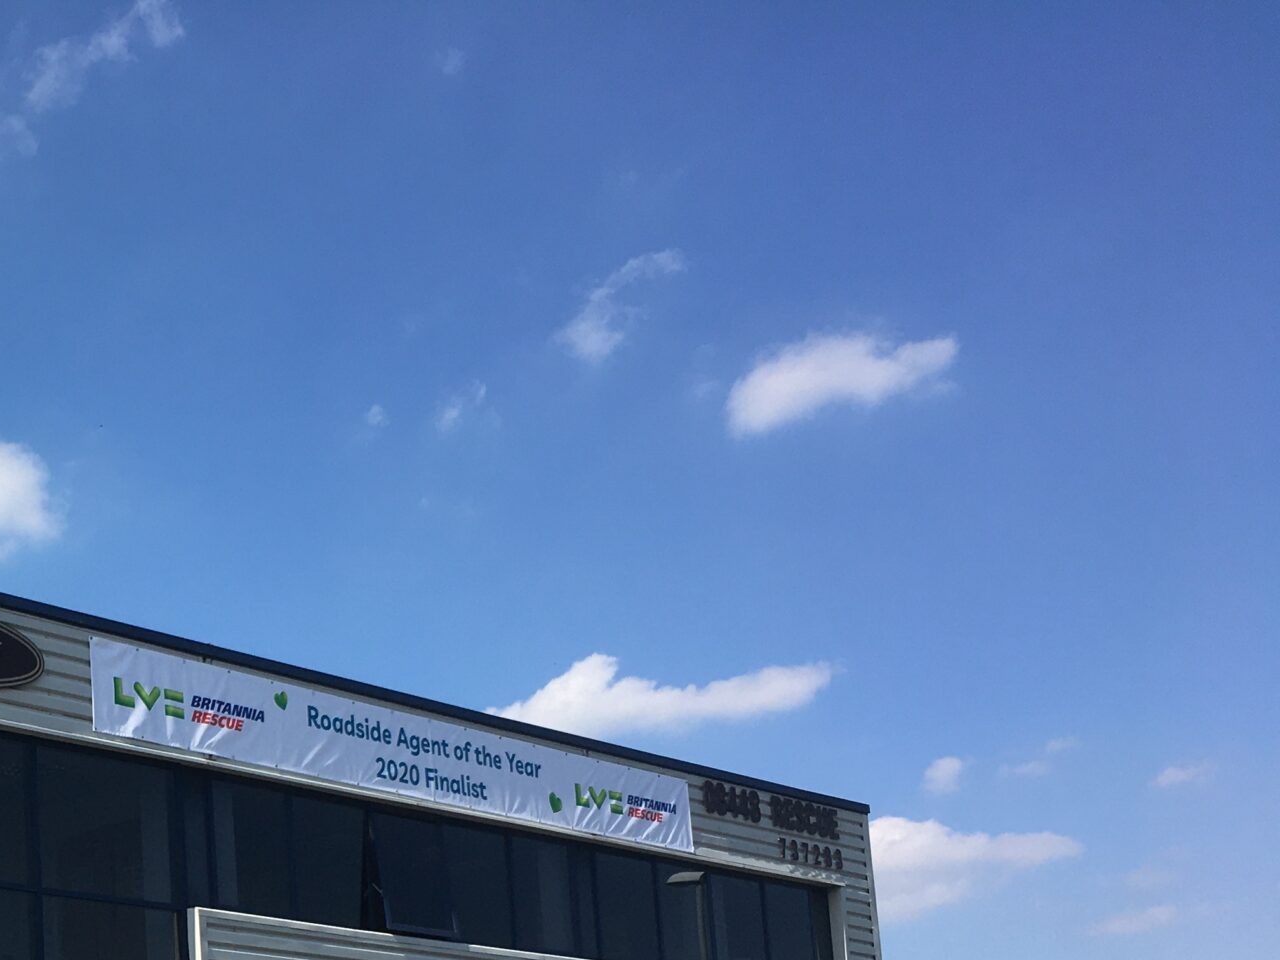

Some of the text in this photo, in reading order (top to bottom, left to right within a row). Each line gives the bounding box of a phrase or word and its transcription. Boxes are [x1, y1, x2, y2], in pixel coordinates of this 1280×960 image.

[191, 695, 265, 723] BRITANNIA
[191, 710, 244, 732] RESCUE
[307, 705, 541, 778] Roadside Agent of the Year
[375, 757, 488, 800] 2020 Finalist
[627, 794, 677, 815] BRITANNIA
[628, 807, 663, 823] RESCUE
